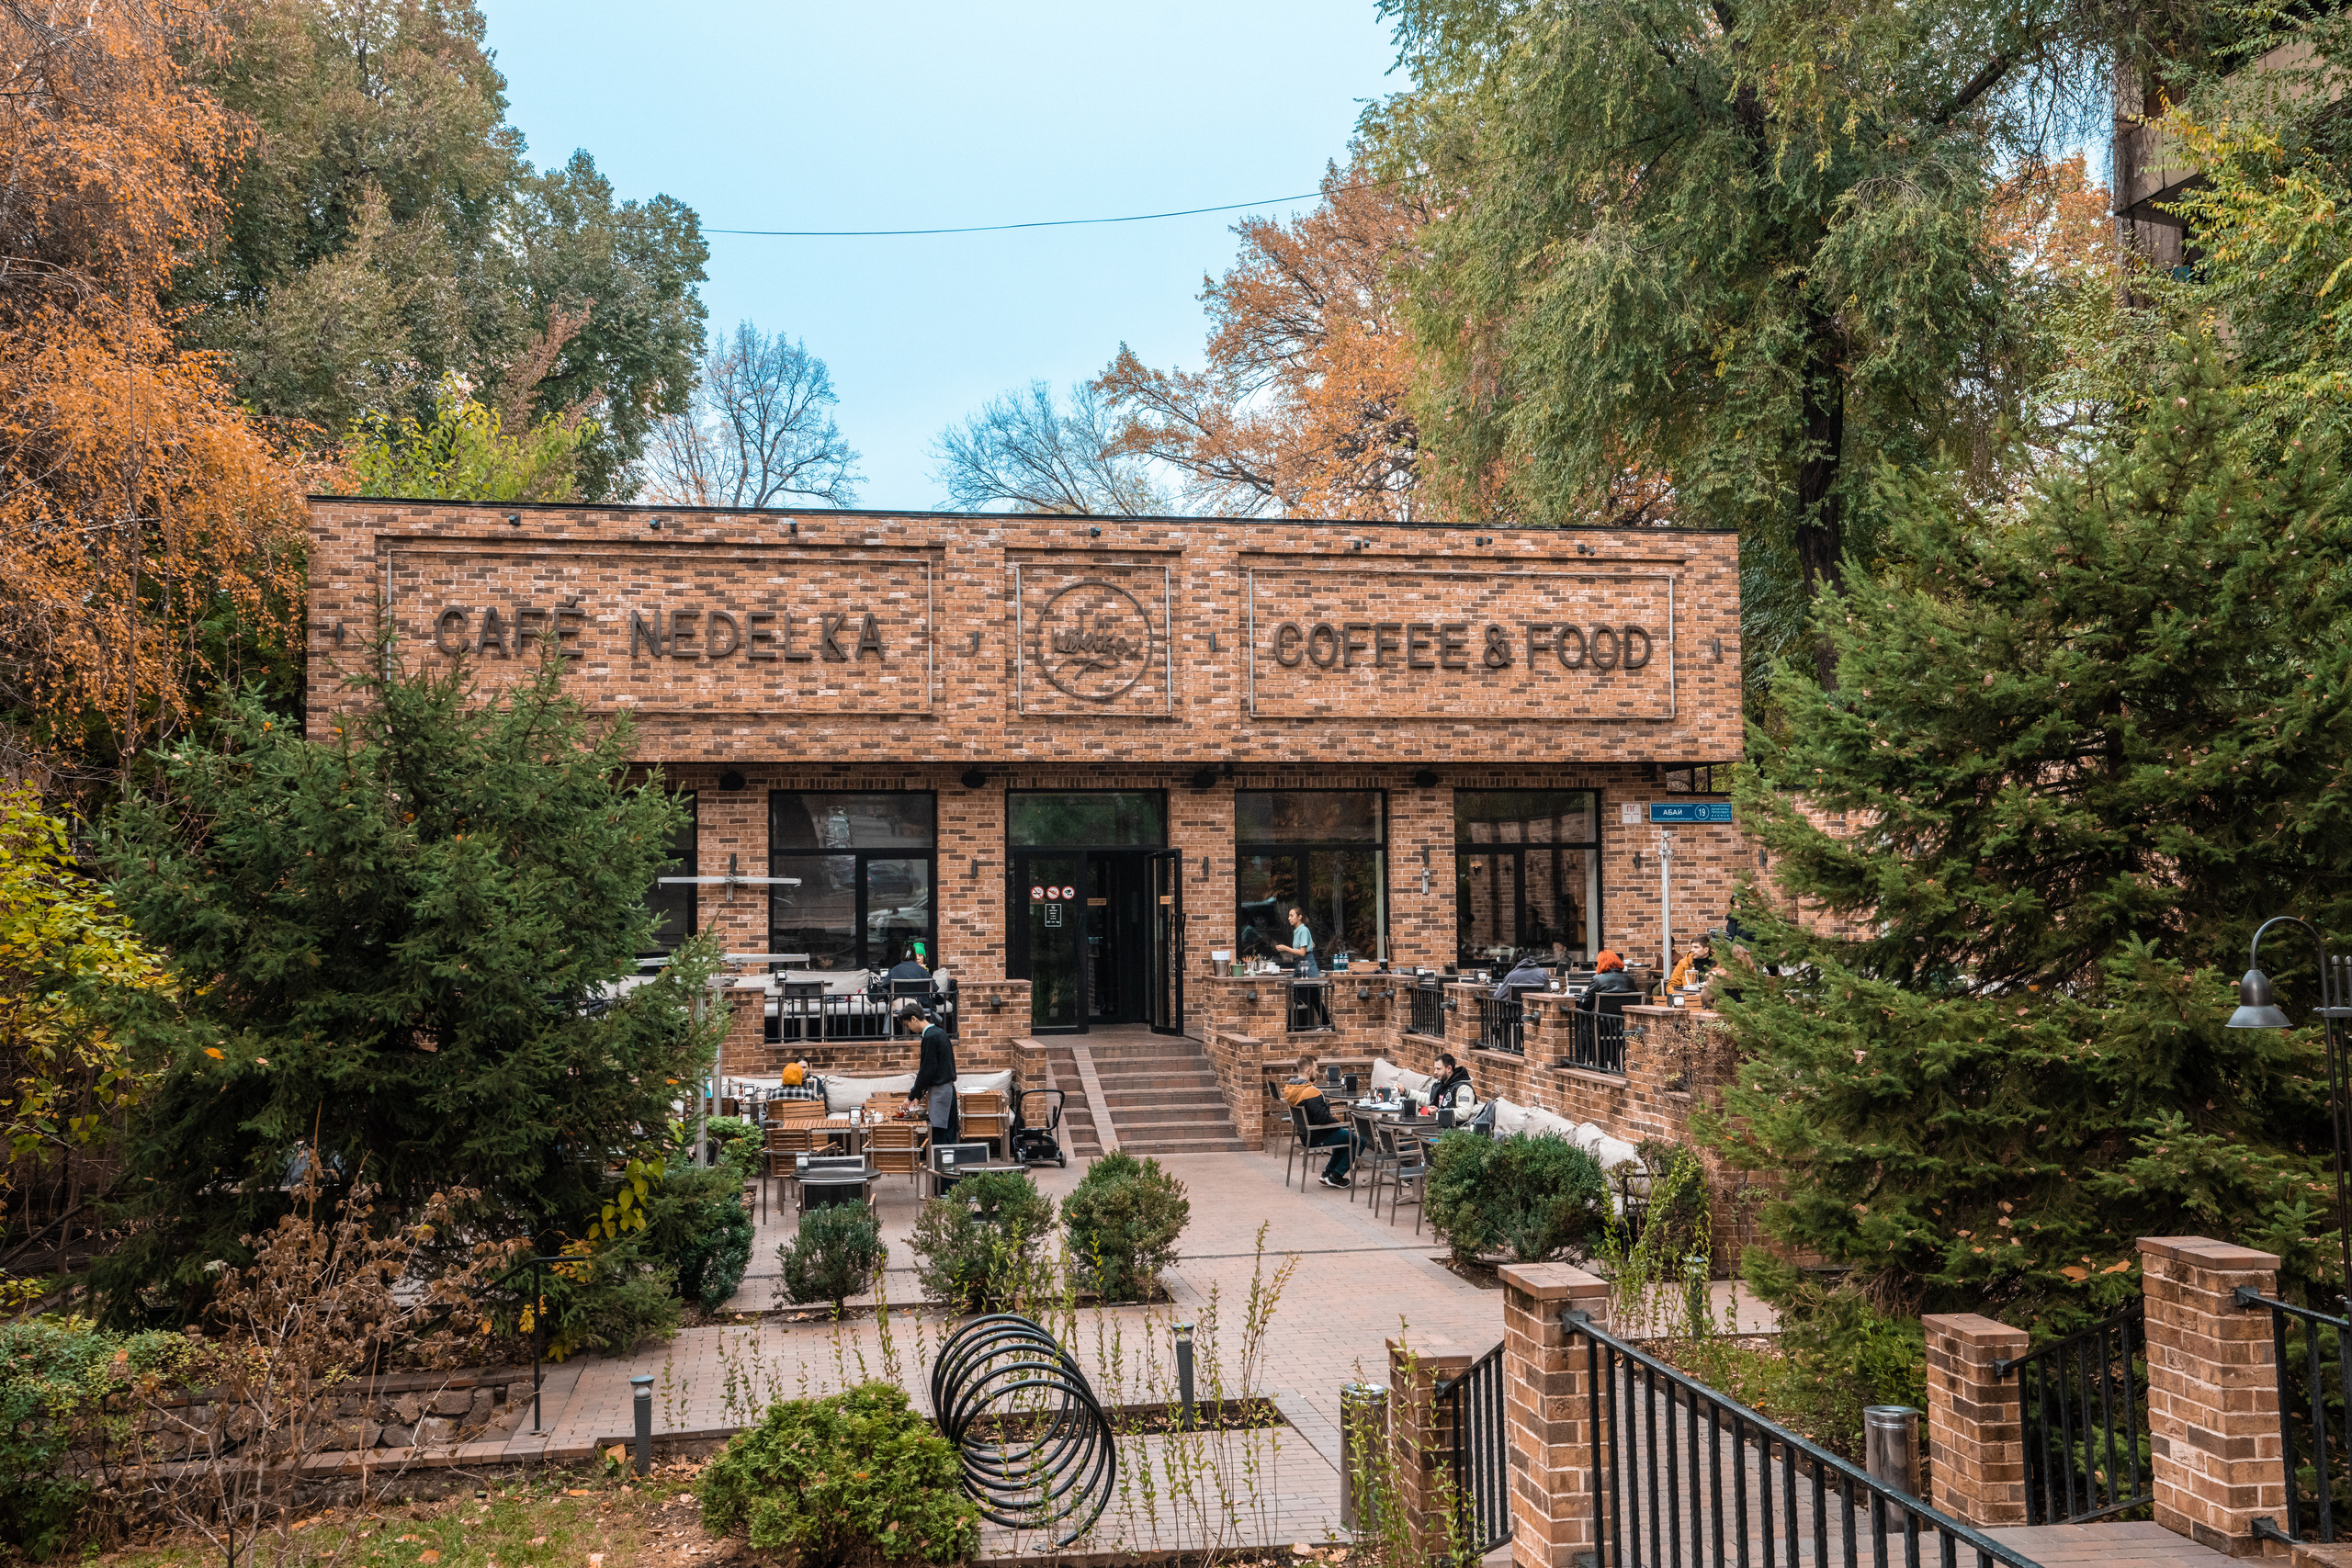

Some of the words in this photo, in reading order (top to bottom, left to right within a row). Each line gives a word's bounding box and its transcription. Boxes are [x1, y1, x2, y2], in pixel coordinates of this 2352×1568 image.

[435, 596, 585, 655] CAFÉ
[629, 608, 885, 660] NEDELKA
[1273, 620, 1468, 668] COFFEE
[1484, 623, 1512, 668] &
[1526, 622, 1653, 671] FOOD
[1698, 808, 1706, 817] 19
